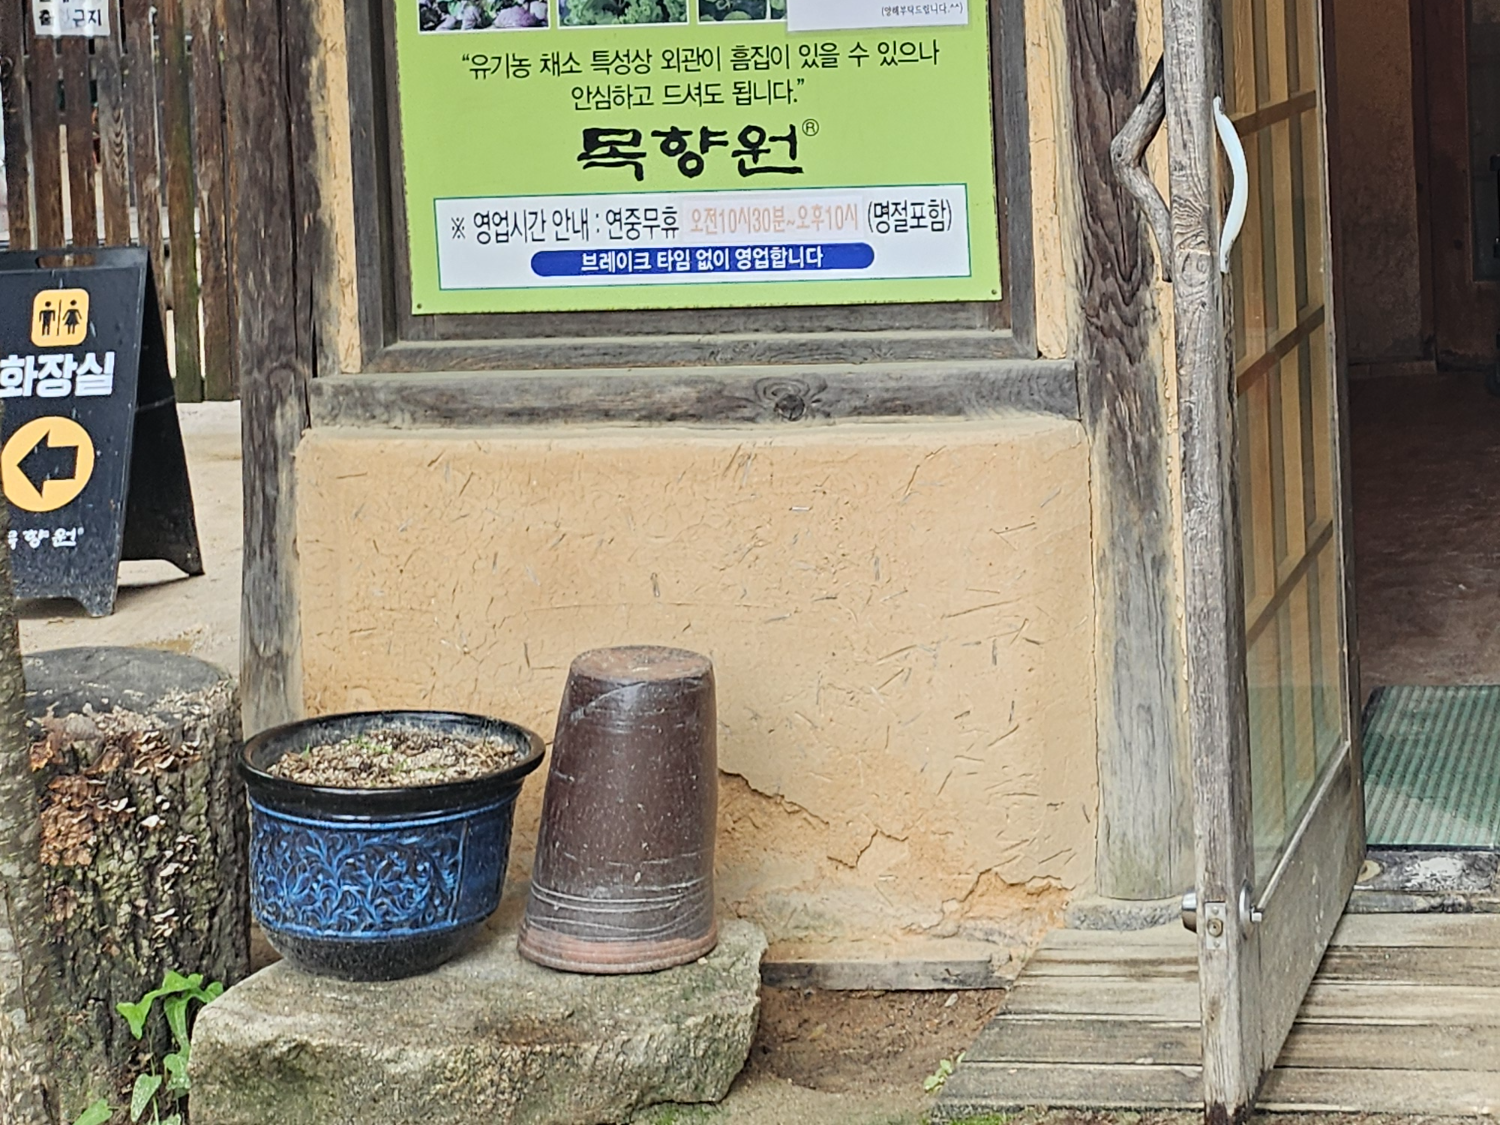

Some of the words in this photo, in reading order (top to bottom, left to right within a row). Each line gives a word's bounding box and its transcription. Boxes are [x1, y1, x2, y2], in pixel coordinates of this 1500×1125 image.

[539, 51, 583, 77] 채소
[590, 48, 653, 75] 특성상
[660, 45, 721, 73] 외관이
[729, 44, 790, 71] 흠집이
[798, 42, 840, 69] 있을
[847, 41, 870, 68] 수
[877, 39, 940, 66] 있으나
[571, 83, 655, 111] 안심하고
[662, 81, 725, 107] 드셔도
[473, 208, 547, 245] 영업시간
[551, 207, 590, 242] 안내
[605, 205, 680, 241] 연중무휴
[867, 198, 953, 235] (명절포함)
[580, 249, 652, 274] 브레이크
[657, 248, 691, 273] 타임
[695, 247, 730, 272] 없이
[735, 245, 824, 271] 영업합니다
[0, 351, 116, 398] 화장실
